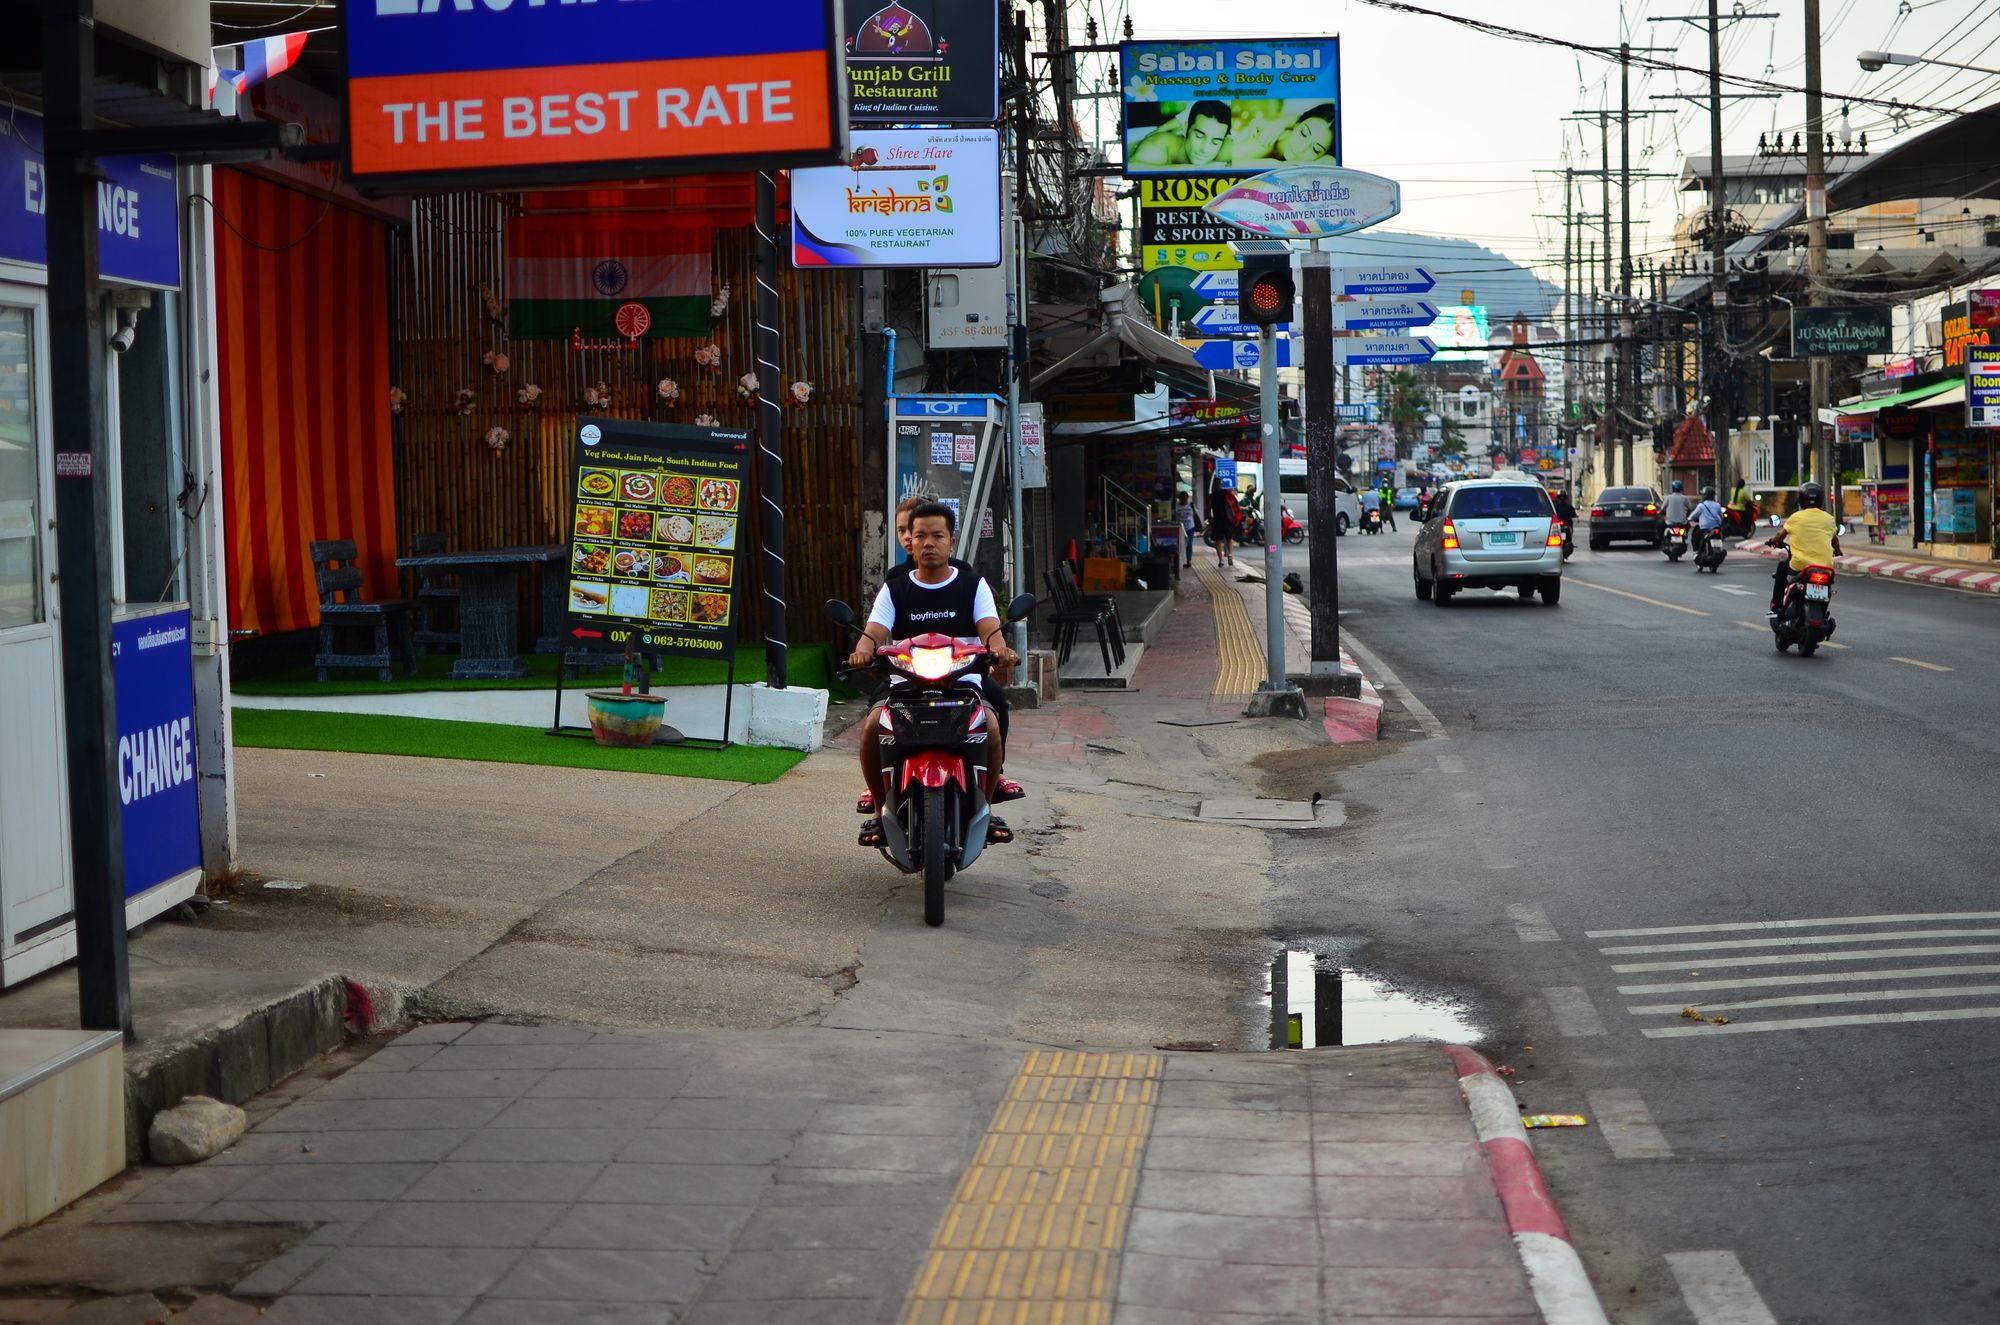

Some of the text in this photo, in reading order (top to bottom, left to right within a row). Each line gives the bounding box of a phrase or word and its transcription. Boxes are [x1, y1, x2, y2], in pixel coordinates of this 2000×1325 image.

[908, 65, 952, 82] Grill
[1146, 71, 1316, 86] Massage & Body Care
[854, 84, 939, 99] Restaurant
[382, 80, 794, 144] THE BEST RATE
[854, 103, 939, 112] King of Indian Cuisine.
[887, 146, 953, 161] Shree Hare
[1150, 178, 1240, 202] ROSC
[845, 187, 931, 217] krishna
[1265, 208, 1356, 222] SAINAMYEN SECTION
[845, 228, 954, 238] 100% PURE VEGETARIAN
[1153, 229, 1167, 242] &
[1171, 227, 1237, 242] SPORTS
[870, 240, 931, 248] RESTAURANT
[1360, 304, 1414, 316] หาดกะหลิม
[1365, 343, 1410, 352] หาดกมลา
[1828, 342, 1859, 353] TATTOO
[916, 401, 968, 414] TOT
[585, 450, 599, 459] Veg
[624, 453, 642, 462] Jain
[666, 457, 690, 466] South
[691, 459, 717, 468] Indian
[718, 461, 739, 470] Food
[910, 610, 949, 622] boyfriend
[653, 635, 723, 651] 062-5705000
